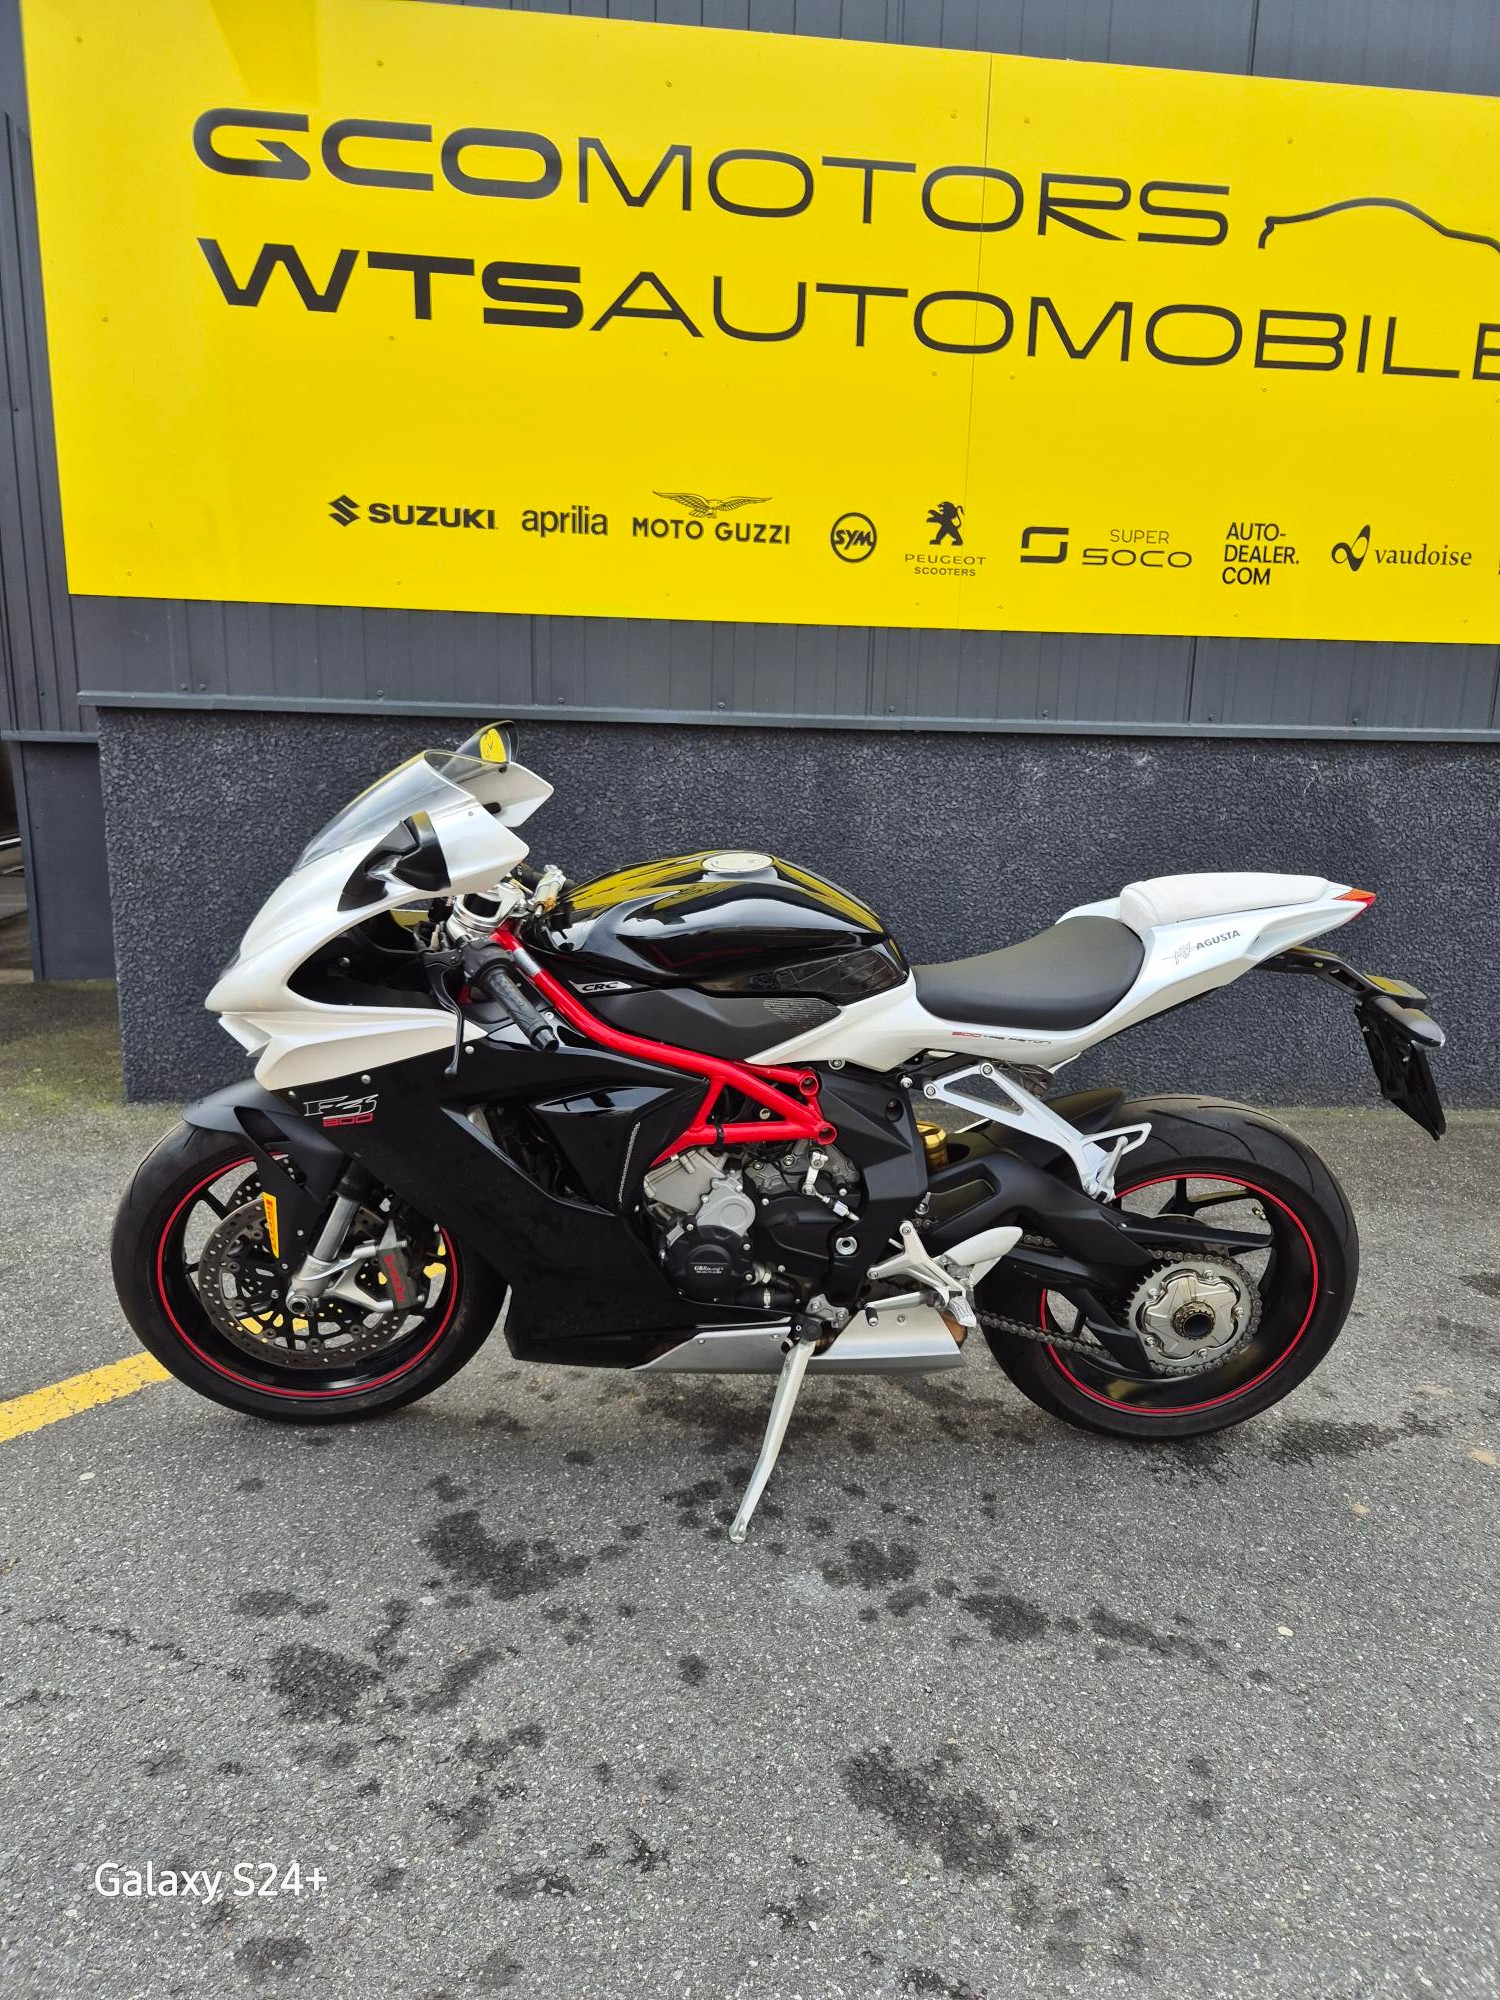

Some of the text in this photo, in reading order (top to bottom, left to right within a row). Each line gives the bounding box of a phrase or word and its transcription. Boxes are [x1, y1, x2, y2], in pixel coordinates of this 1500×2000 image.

[368, 502, 495, 530] SUZUKI
[521, 504, 608, 538] aprilia
[632, 517, 790, 545] MOTO GUZZI
[835, 529, 872, 551] SYM
[1110, 529, 1170, 544] SUPER
[1226, 522, 1286, 542] AUTO-
[904, 553, 986, 566] PEUGEOT
[1082, 548, 1193, 568] SOCO
[1224, 544, 1300, 565] DEALER.
[1375, 543, 1472, 566] vaudoise
[914, 566, 976, 577] SCOOTERS
[1222, 566, 1271, 586] COM
[1196, 929, 1241, 951] AGUSTA
[582, 981, 619, 992] CRC
